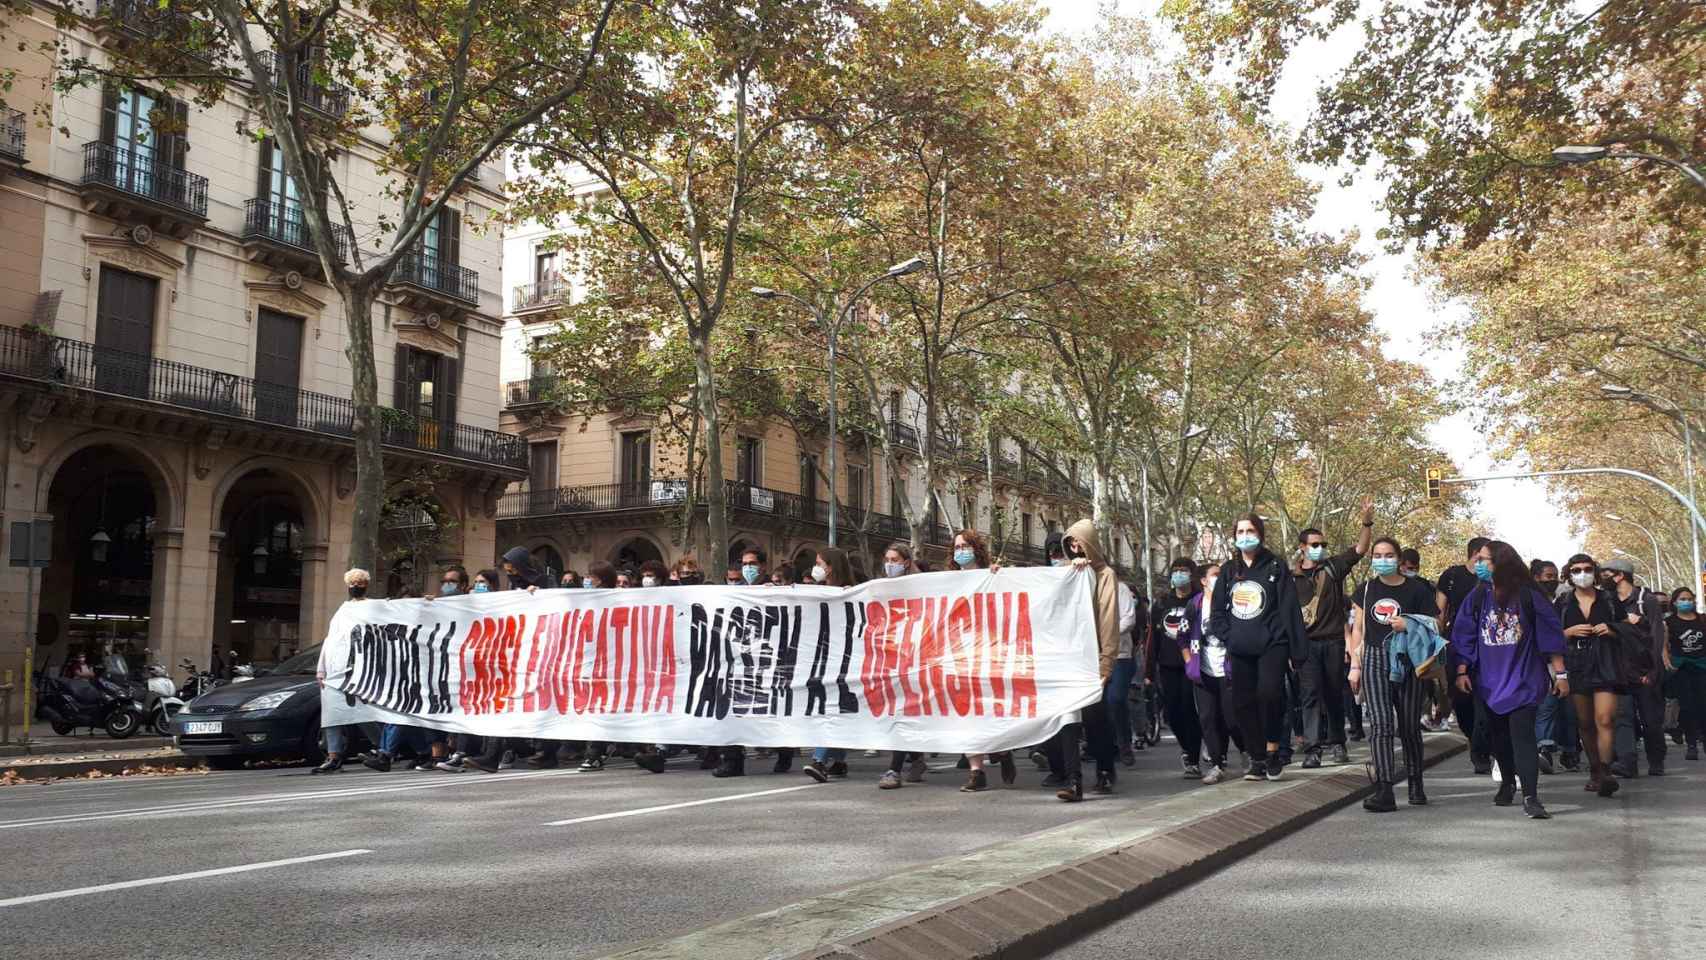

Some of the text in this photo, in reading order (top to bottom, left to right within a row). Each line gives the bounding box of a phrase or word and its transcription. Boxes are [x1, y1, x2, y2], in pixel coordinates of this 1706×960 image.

[339, 592, 1037, 720] CONTRA LA CRISI EDUCATIVA PASSEM A L'OFENSIVA
